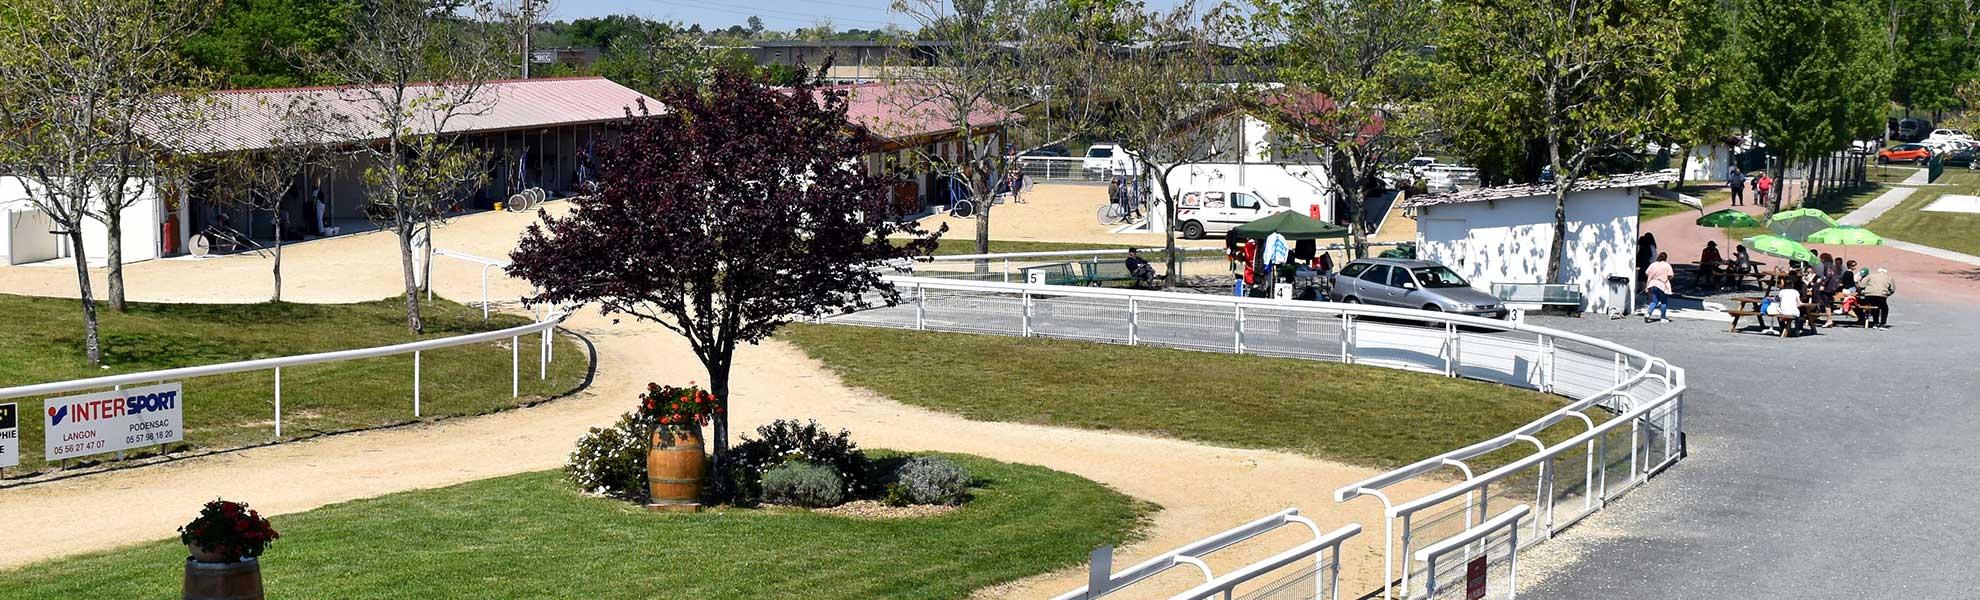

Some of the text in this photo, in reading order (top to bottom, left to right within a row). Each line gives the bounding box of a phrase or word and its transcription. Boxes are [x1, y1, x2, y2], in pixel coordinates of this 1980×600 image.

[71, 390, 177, 423] INTERSPORT
[129, 419, 169, 432] PODENSAC
[0, 430, 17, 440] HIE
[63, 430, 96, 442] LANGON
[126, 429, 173, 444] 05 57 98 18 20
[54, 440, 105, 455] 05 56 27 47 07
